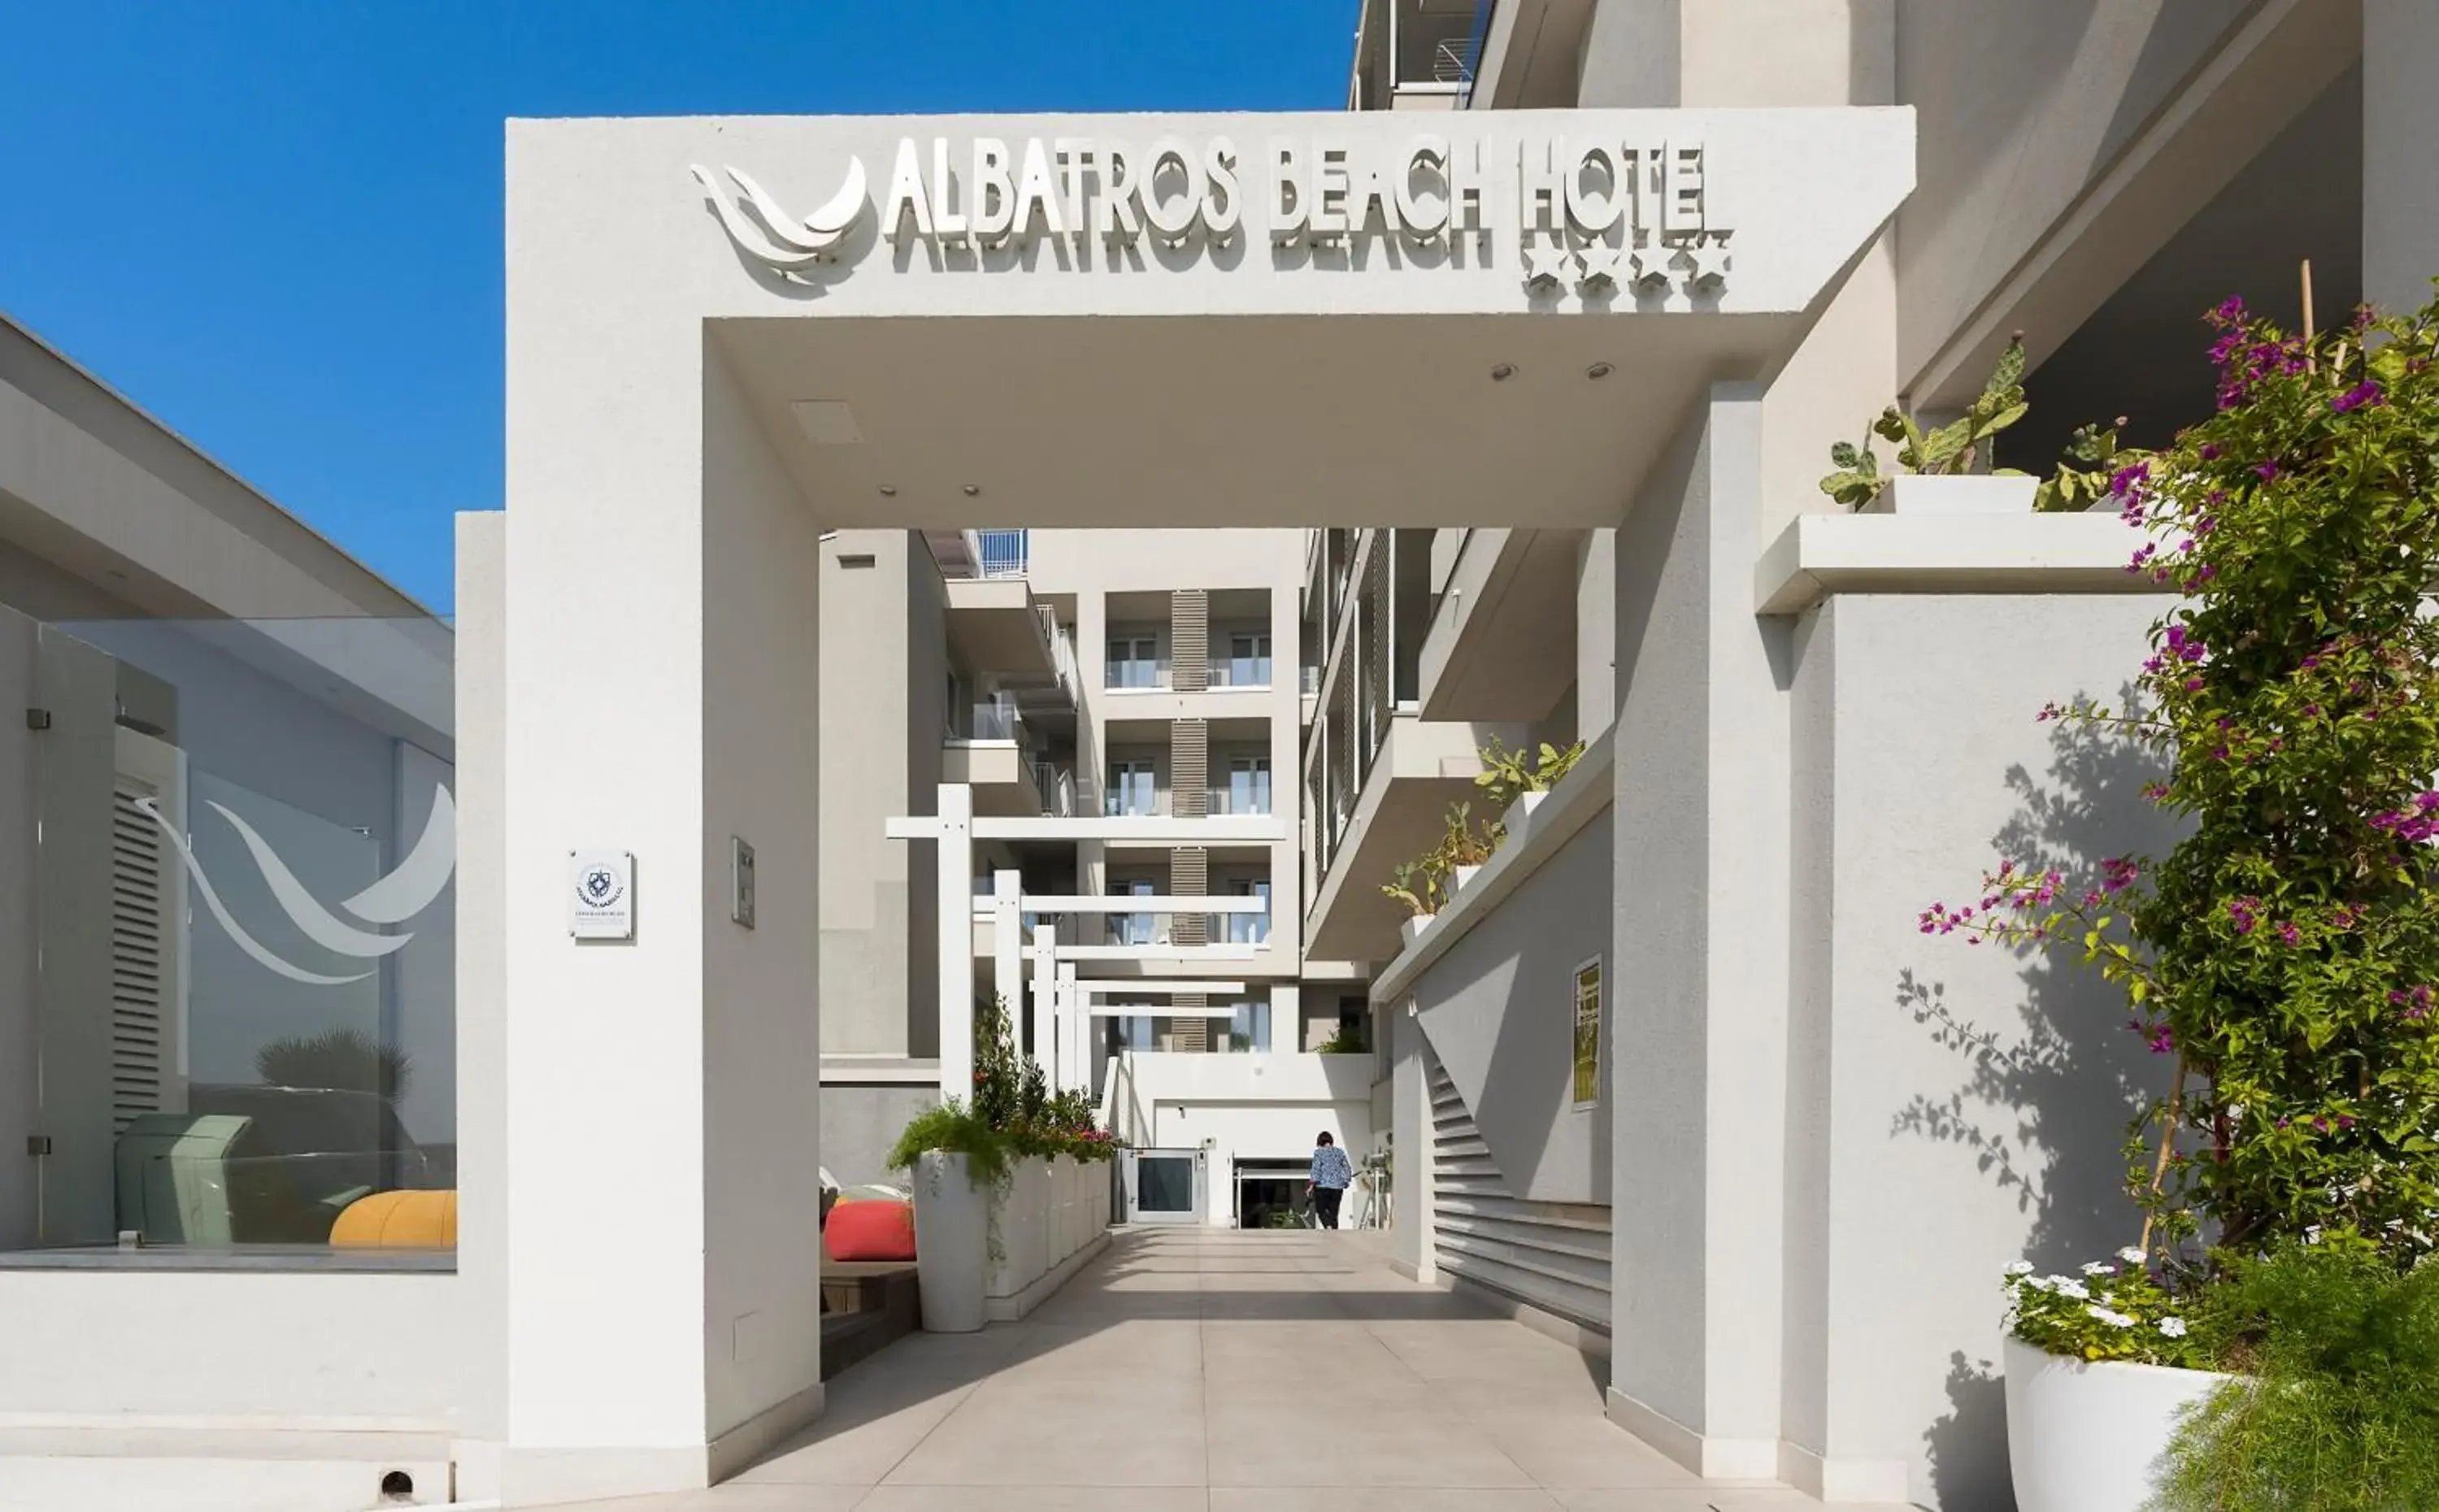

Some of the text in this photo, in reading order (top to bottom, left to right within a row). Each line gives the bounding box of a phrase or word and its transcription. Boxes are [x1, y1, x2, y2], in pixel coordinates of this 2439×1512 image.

[883, 133, 1732, 237] ALBATROS BEACH HOTEL
